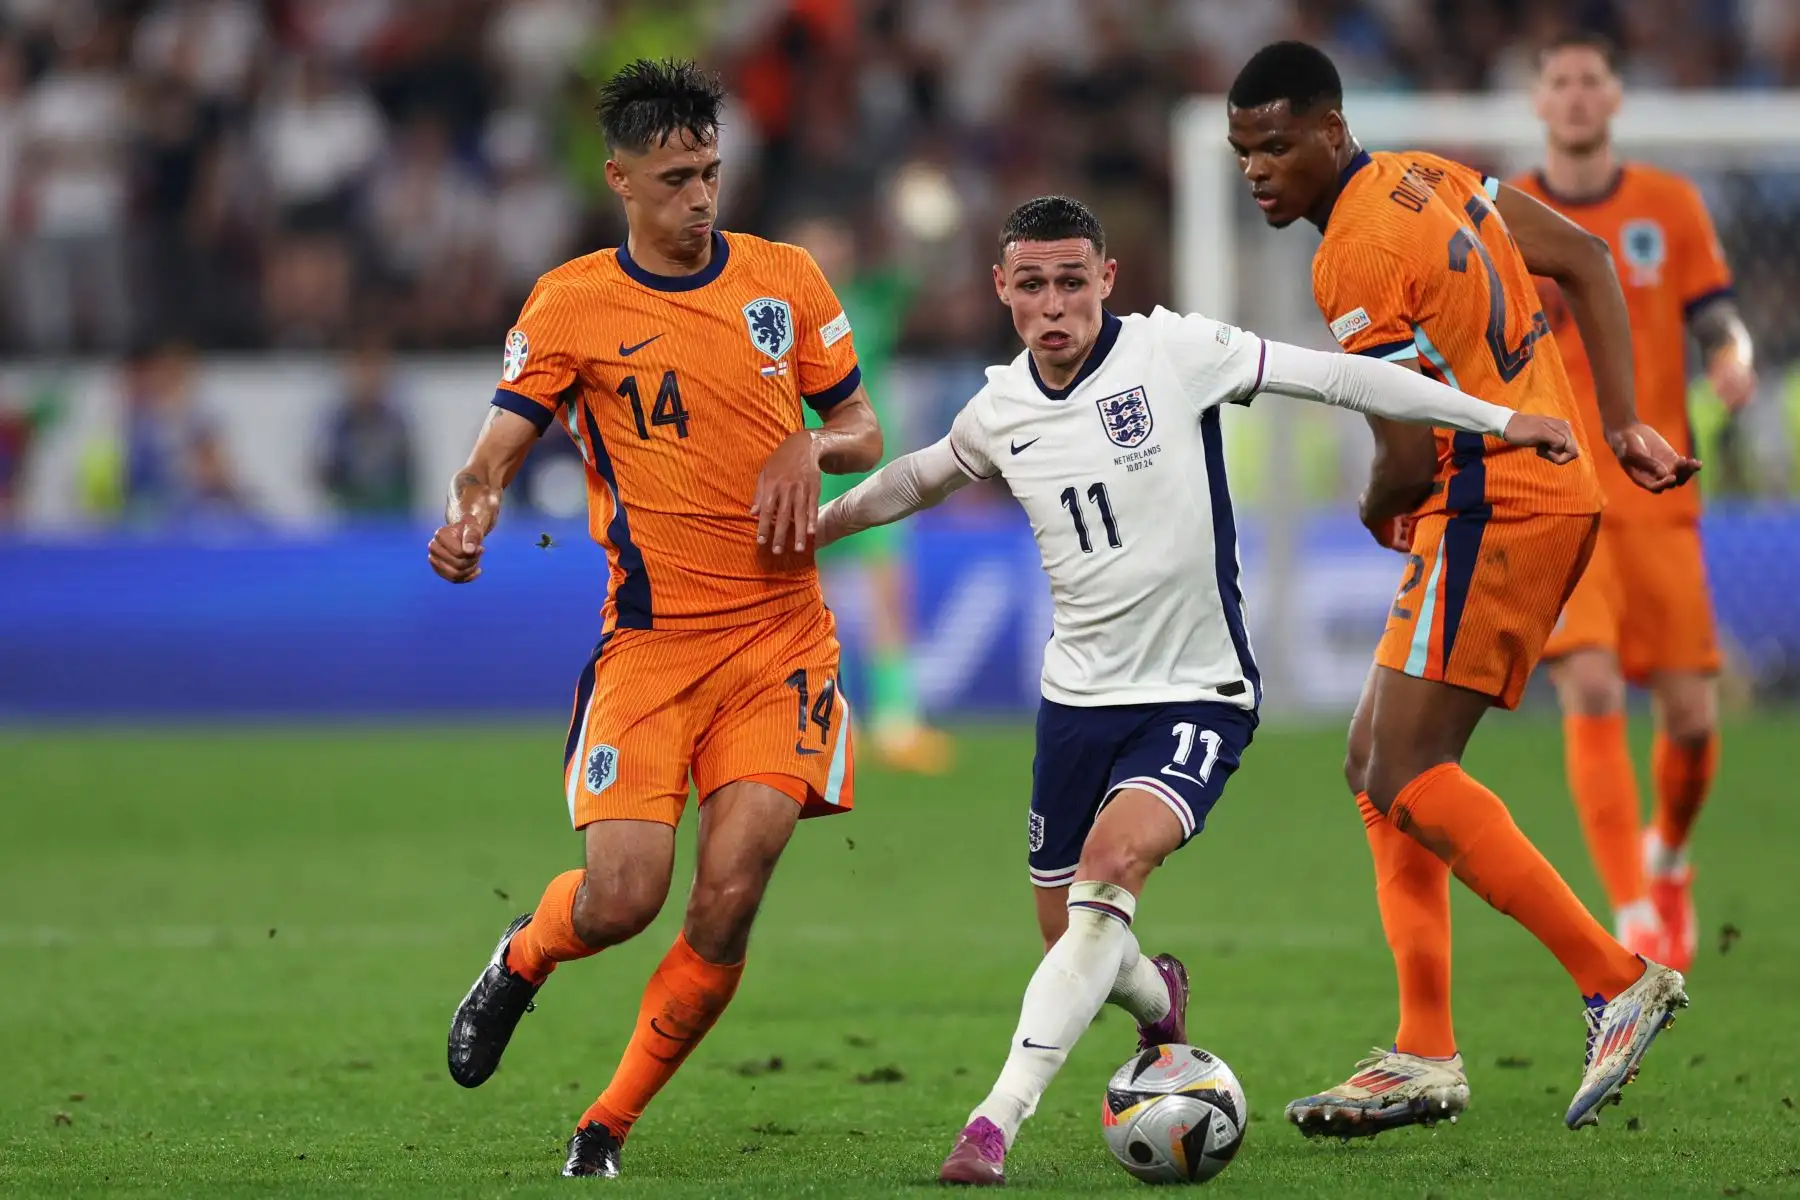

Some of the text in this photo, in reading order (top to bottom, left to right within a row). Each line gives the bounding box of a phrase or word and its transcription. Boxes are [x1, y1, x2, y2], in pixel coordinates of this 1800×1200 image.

[616, 370, 689, 440] 14
[1113, 444, 1162, 466] NETHERLANDS
[1060, 482, 1122, 553] 11
[784, 668, 835, 745] 14
[1172, 721, 1222, 783] 11
